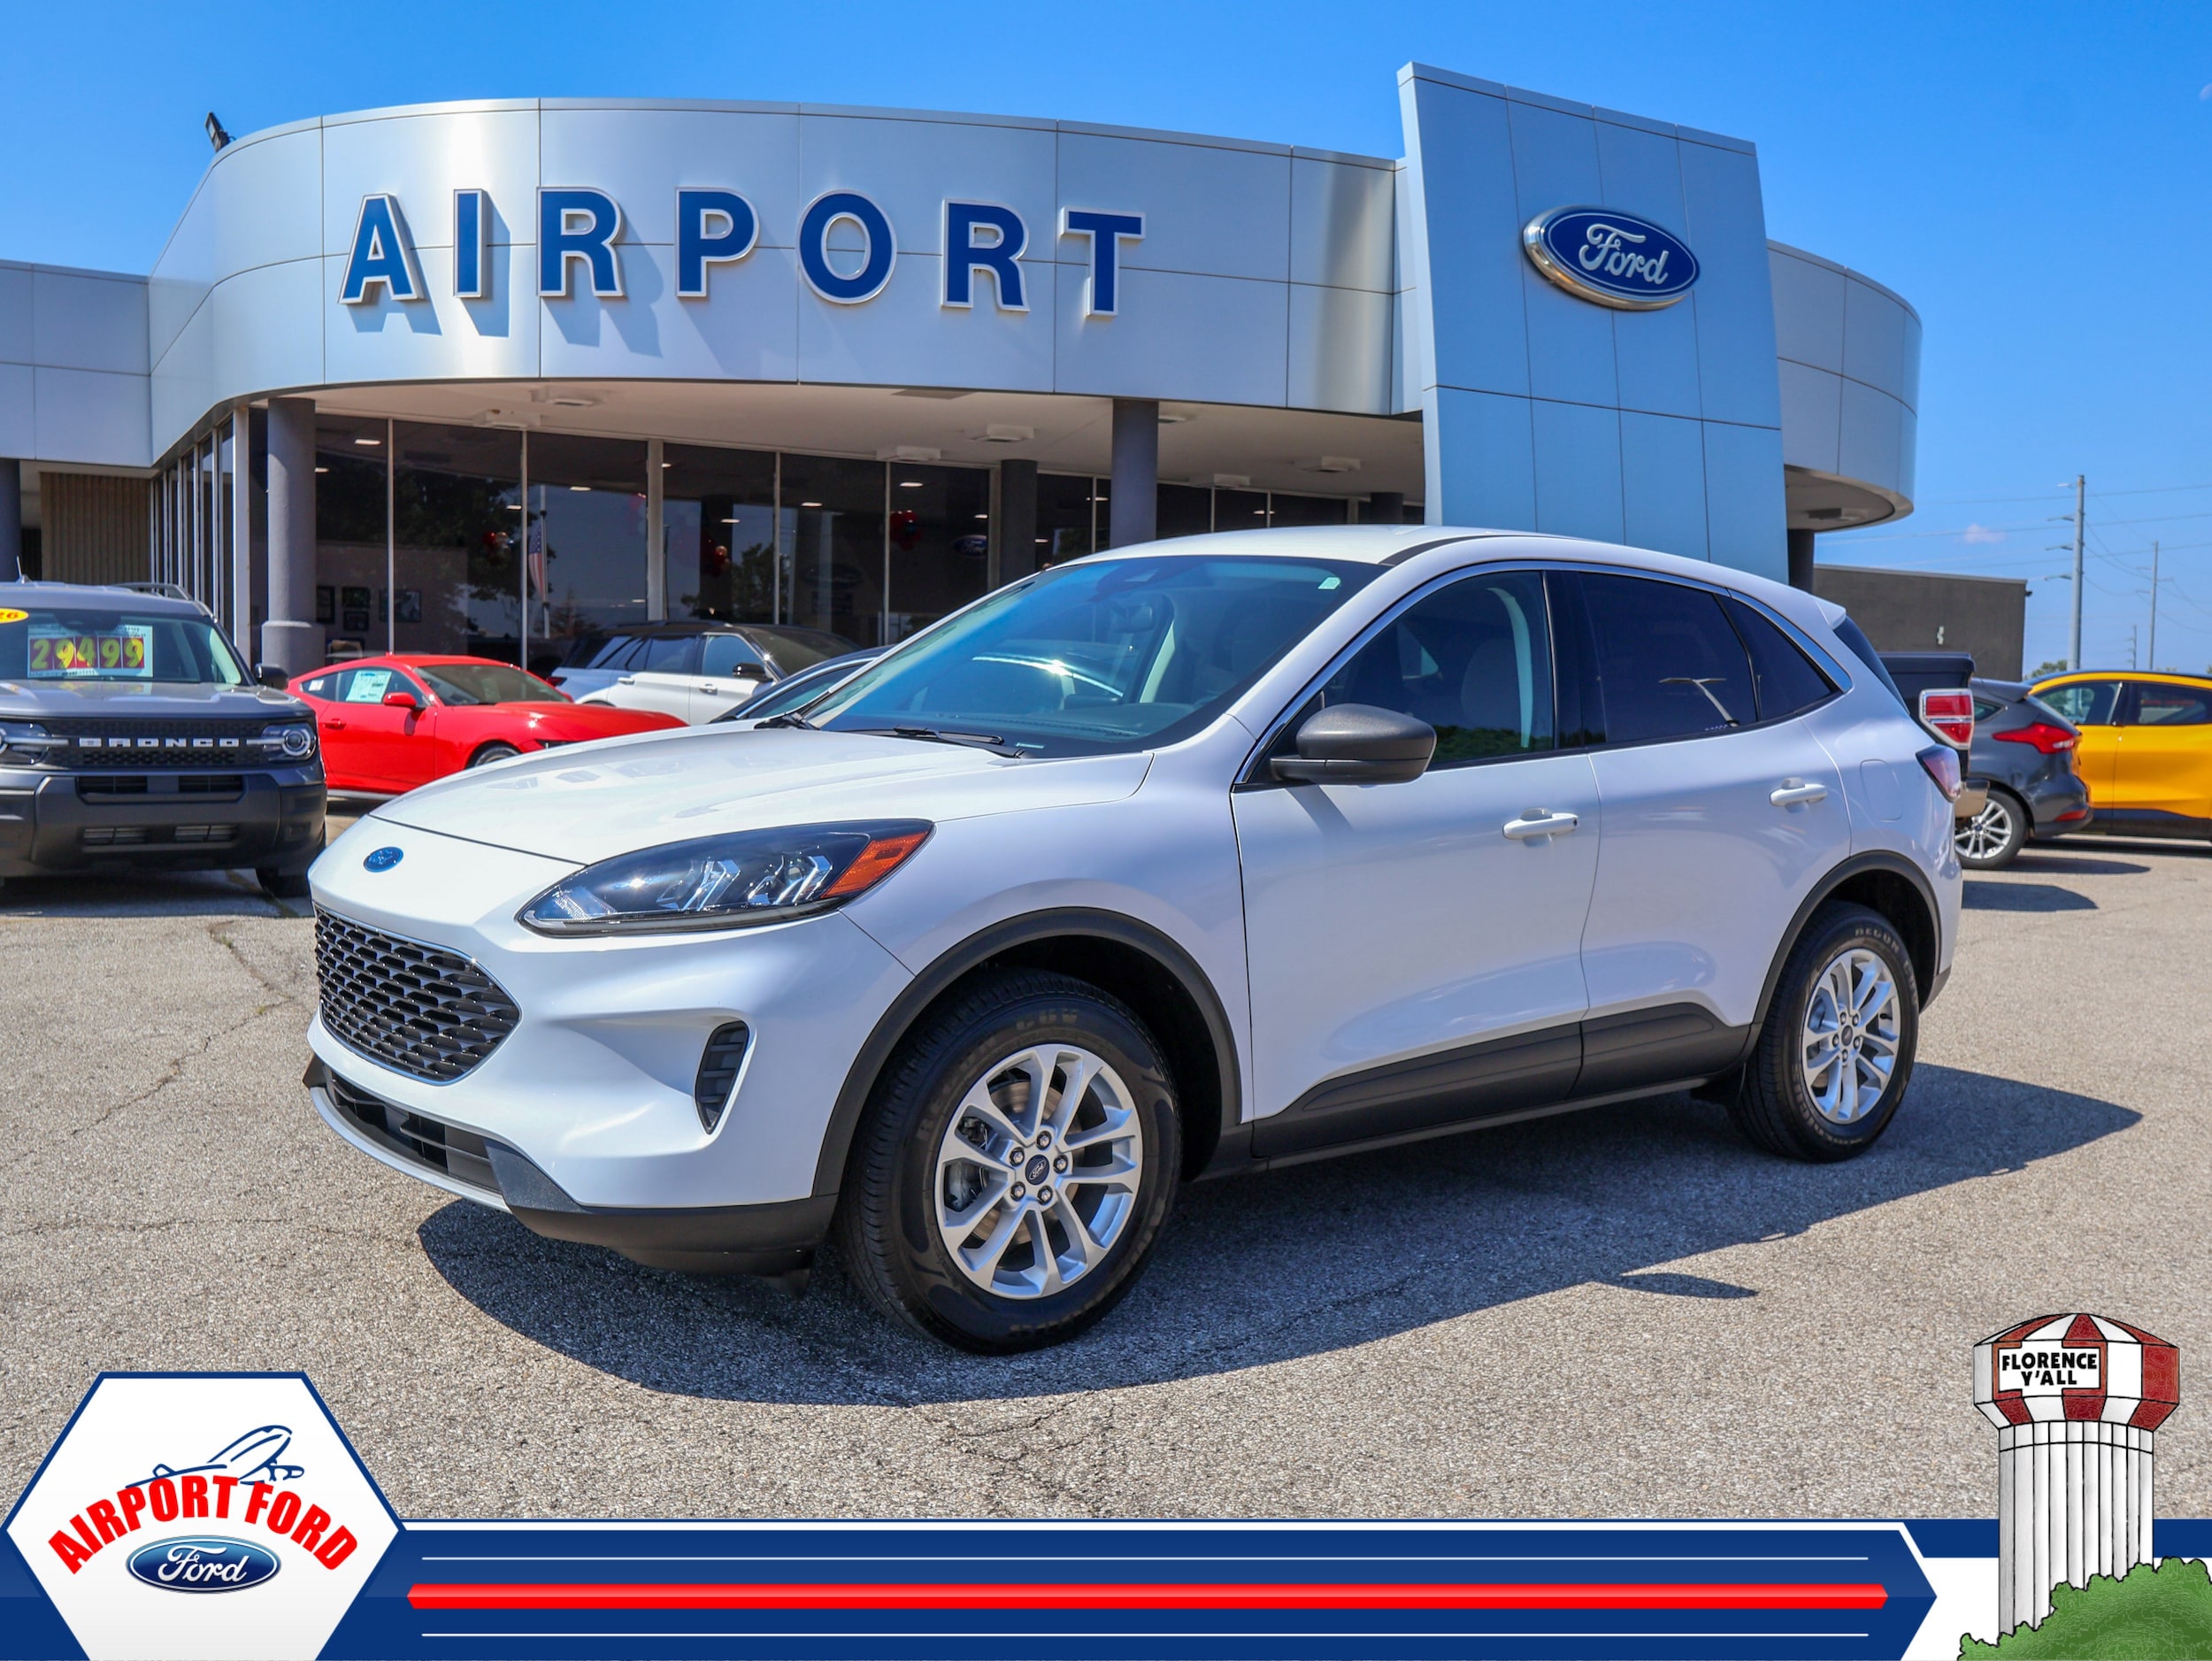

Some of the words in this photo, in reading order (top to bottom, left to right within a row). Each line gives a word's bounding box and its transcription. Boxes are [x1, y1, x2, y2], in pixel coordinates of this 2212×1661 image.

[338, 187, 1146, 317] AIRPORT
[1578, 223, 1669, 284] Ford
[31, 636, 144, 670] 29499
[79, 737, 240, 748] BRONCO
